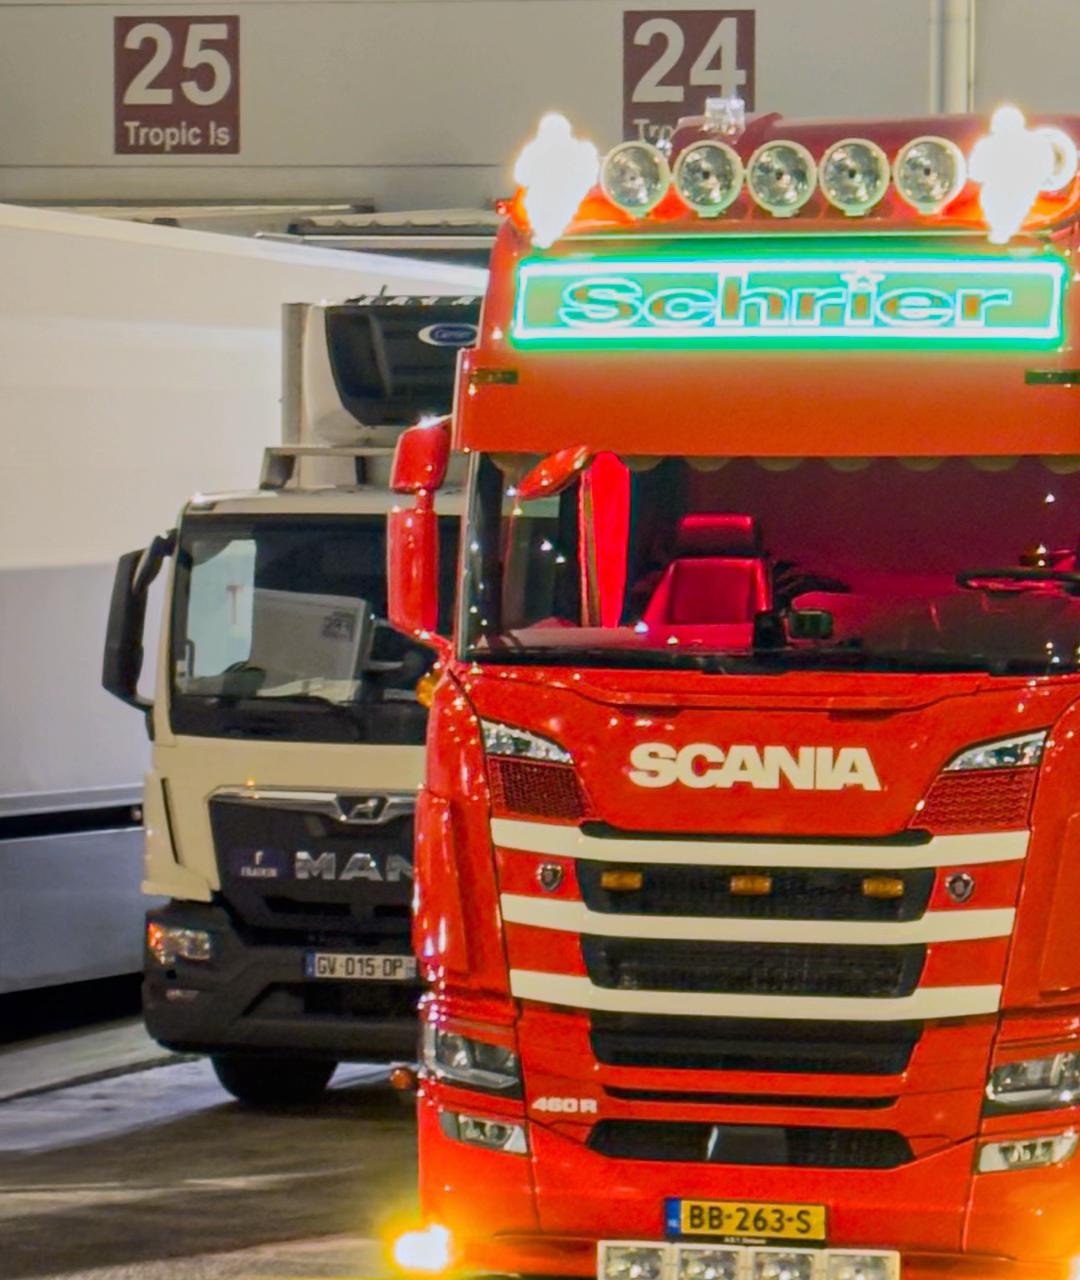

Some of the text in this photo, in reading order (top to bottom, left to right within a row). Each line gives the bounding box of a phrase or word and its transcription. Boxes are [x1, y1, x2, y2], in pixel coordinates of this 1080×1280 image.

[123, 22, 232, 106] 25
[631, 17, 747, 103] 24
[124, 120, 203, 152] Tropic
[557, 270, 1013, 330] Schrier
[628, 742, 882, 791] SCANIA
[689, 1204, 812, 1234] BB-263-S
